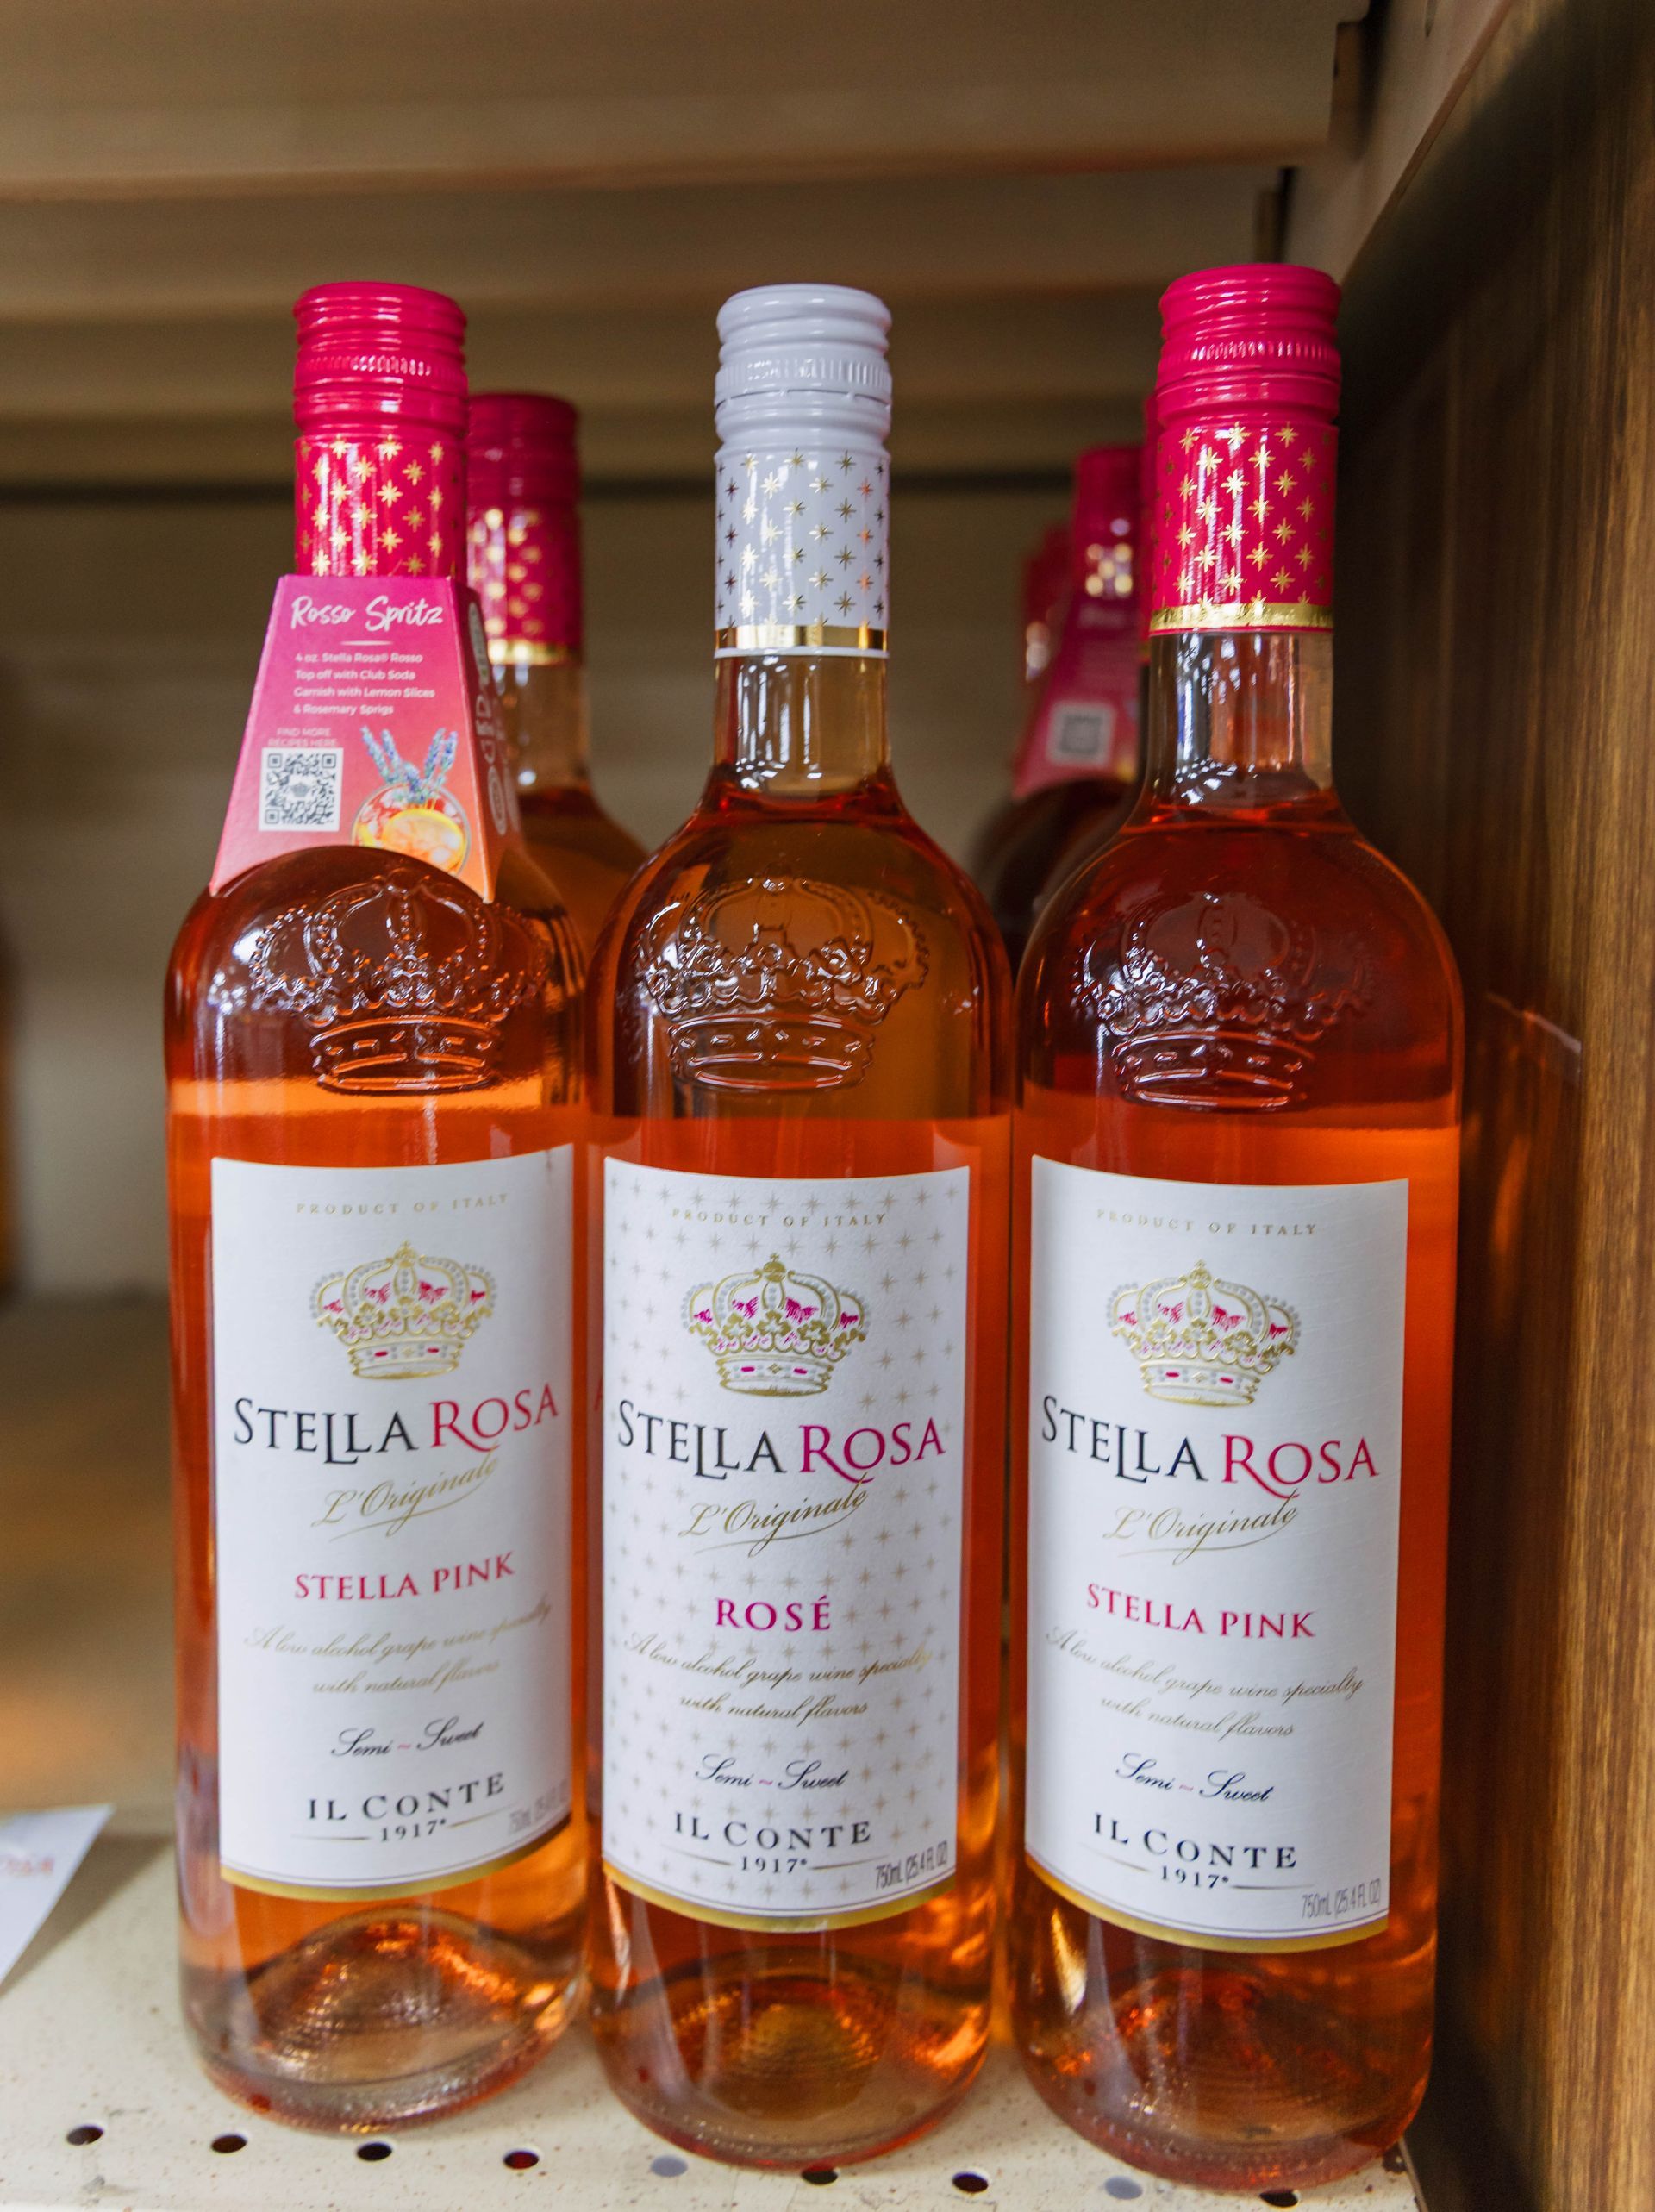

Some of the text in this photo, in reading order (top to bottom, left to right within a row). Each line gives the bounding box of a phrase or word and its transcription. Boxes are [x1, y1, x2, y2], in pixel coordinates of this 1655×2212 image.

[290, 595, 444, 632] Rosso Spritz
[295, 653, 303, 663] 4
[322, 652, 353, 663] Stella
[390, 653, 423, 663] Rosso
[295, 669, 415, 681] Top off with Club Soda
[293, 687, 435, 698] Garnish with Lemon Slices
[303, 704, 357, 716] Rosemary
[359, 704, 394, 717] Sprigs
[297, 1193, 509, 1215] PRODUCT OF ITALY
[671, 1208, 887, 1227] PRODUCT OF ITALY
[1096, 1208, 1317, 1236] PRODUCT OF ITALY
[234, 1383, 559, 1465] STELLA ROSA
[617, 1399, 946, 1484] STELLA ROSA
[1041, 1394, 1380, 1499] STELLA ROSA
[310, 1445, 499, 1537] L'Originale
[678, 1472, 868, 1558] L'Originale
[1102, 1488, 1298, 1566] L'Originale
[295, 1551, 516, 1601] STELLA PINK
[715, 1594, 832, 1632] ROSÉ
[1086, 1583, 1316, 1639] STELLA PINK
[243, 1624, 285, 1648] A
[311, 1632, 391, 1657] alcohol
[373, 1636, 437, 1665] grape
[624, 1632, 658, 1655] A
[649, 1641, 678, 1665] low
[680, 1651, 757, 1679] alcohol
[739, 1667, 802, 1690] grape
[809, 1665, 856, 1681] wine
[313, 1670, 367, 1693] with
[364, 1660, 451, 1693] natural
[1046, 1626, 1363, 1706] A low alcohol grape wine specialty
[680, 1692, 868, 1728] with natural flavors
[1101, 1697, 1294, 1742] with natural flavors
[331, 1728, 392, 1758] Semi
[415, 1716, 486, 1751] Sweet
[696, 1753, 752, 1789] Semi
[778, 1759, 849, 1790] Sweet
[1115, 1753, 1176, 1790] Semi
[1199, 1770, 1275, 1803] Sweet
[308, 1798, 347, 1821] IL
[362, 1772, 505, 1820] CONTE
[675, 1812, 871, 1851] IL CONTE
[1094, 1813, 1297, 1871] IL CONTE
